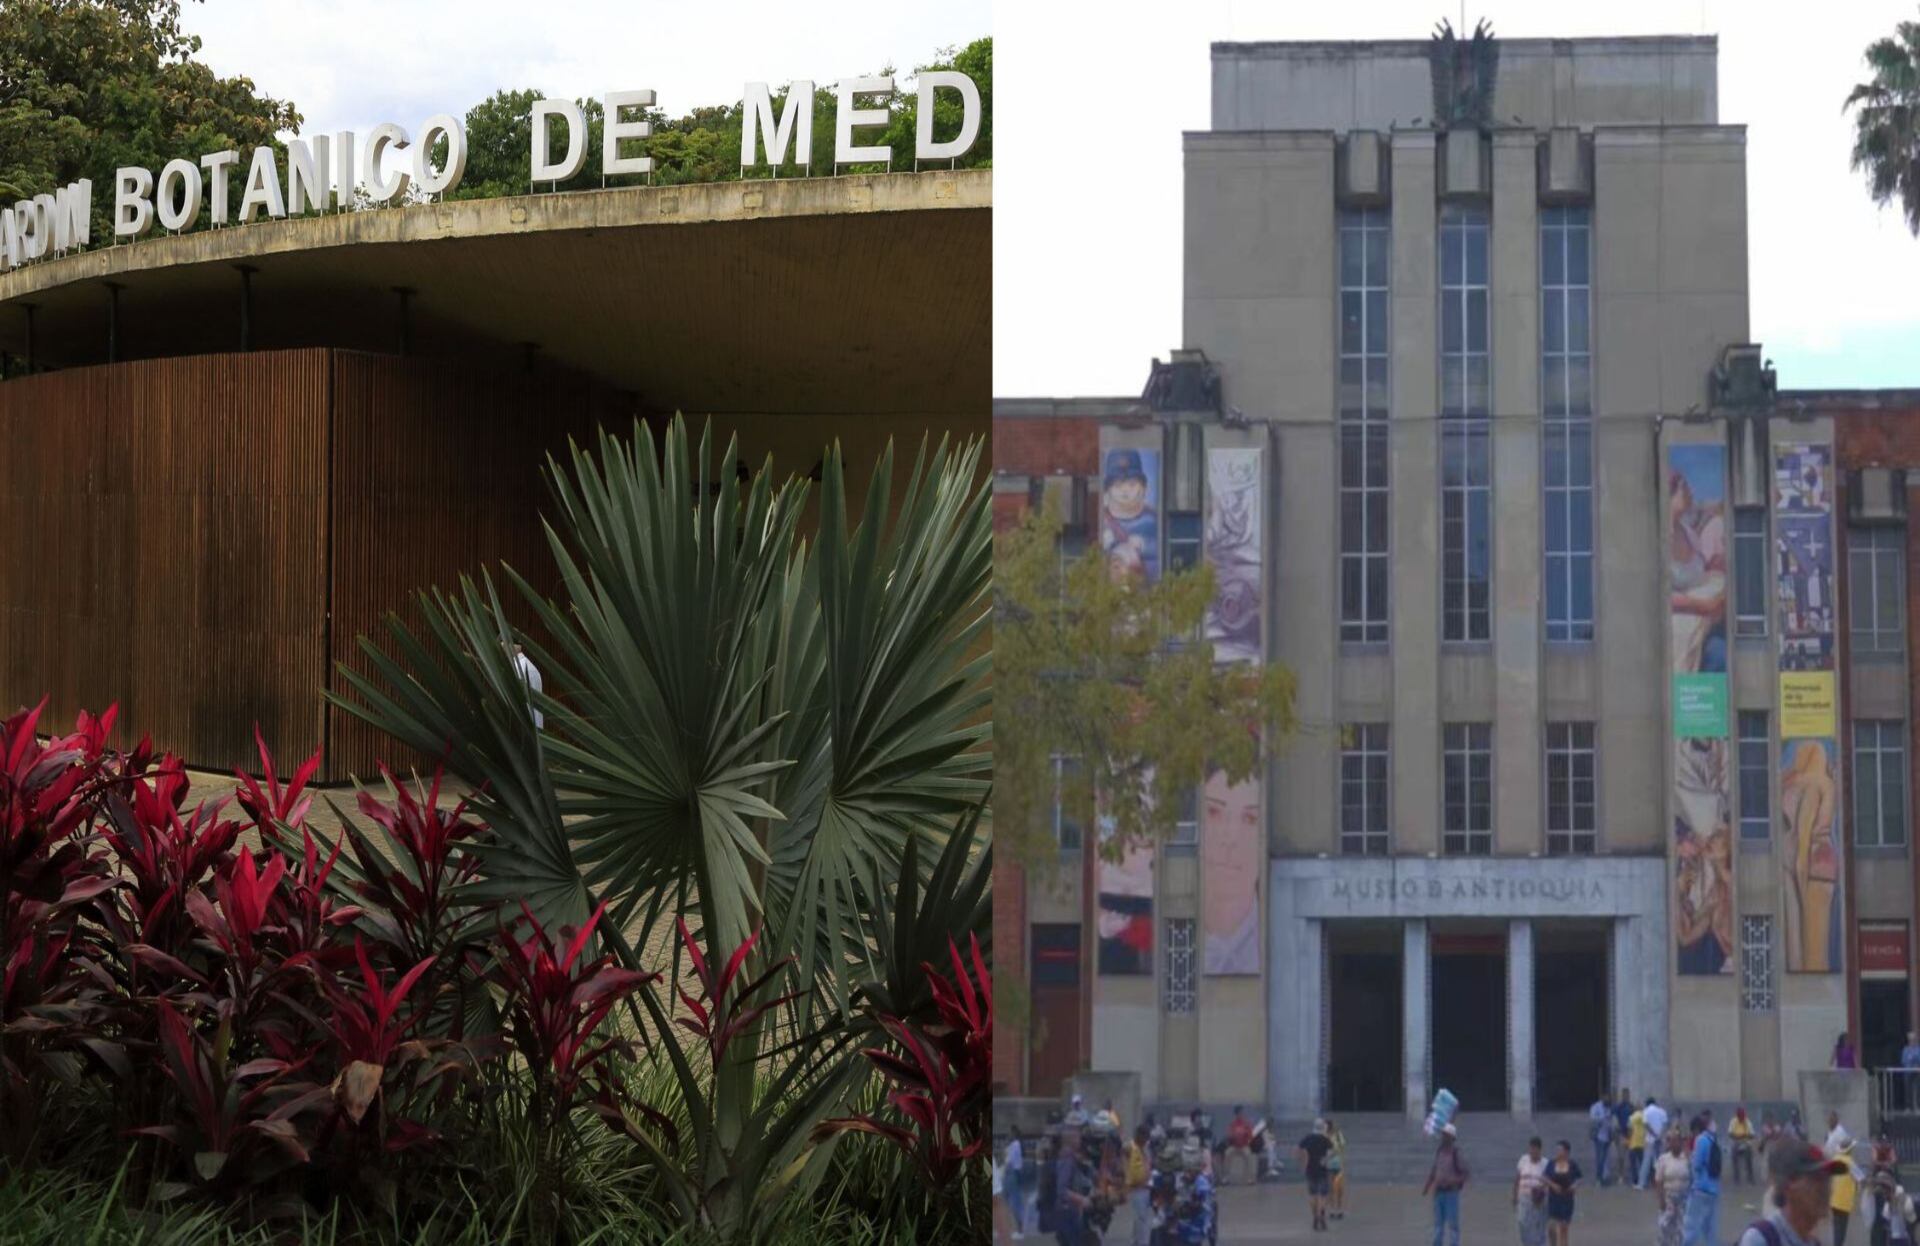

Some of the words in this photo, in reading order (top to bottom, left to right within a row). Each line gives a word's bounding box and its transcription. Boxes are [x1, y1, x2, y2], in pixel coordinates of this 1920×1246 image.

[115, 114, 468, 237] BOTANICO
[530, 89, 657, 182] DE
[740, 71, 982, 166] MED
[1452, 877, 1604, 902] ANTIOQUIA
